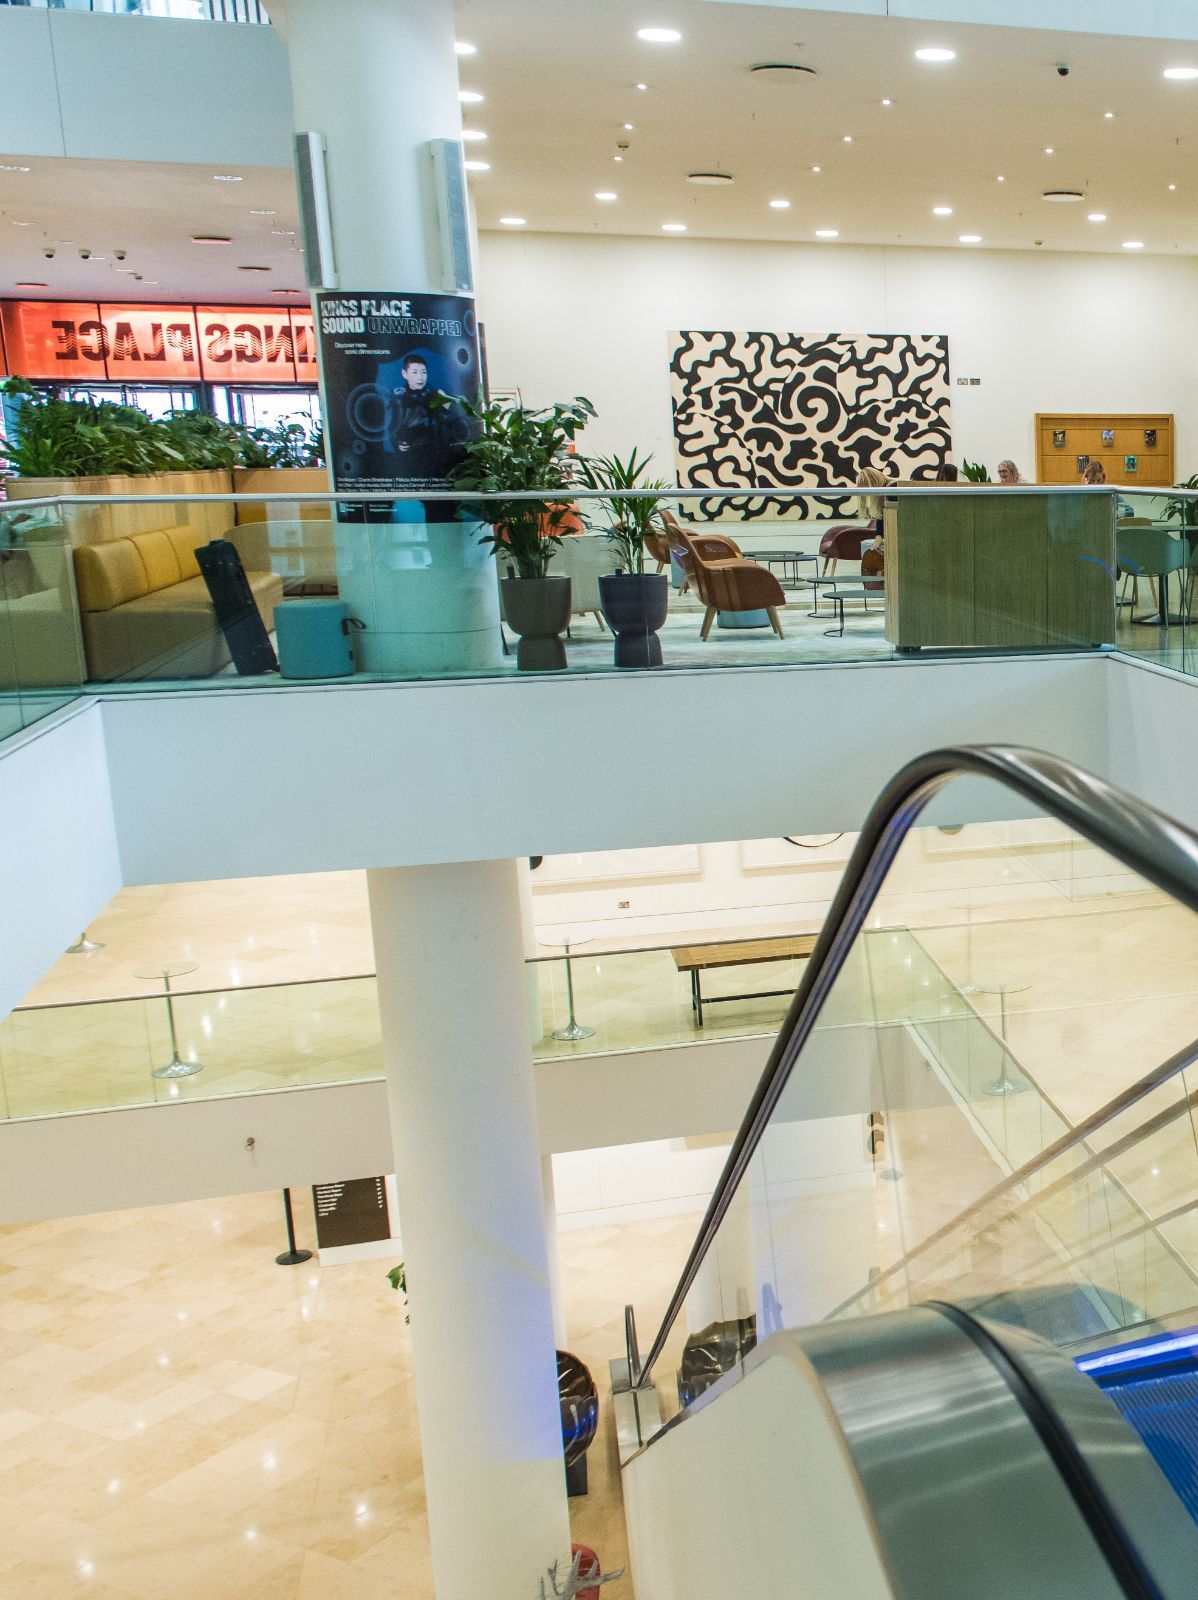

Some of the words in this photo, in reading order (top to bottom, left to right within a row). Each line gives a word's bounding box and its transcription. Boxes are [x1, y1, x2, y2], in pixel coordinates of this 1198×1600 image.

[321, 300, 358, 317] KINGS
[361, 300, 412, 317] PLACE
[322, 317, 365, 334] SOUND
[367, 317, 461, 336] UNWRAPPED
